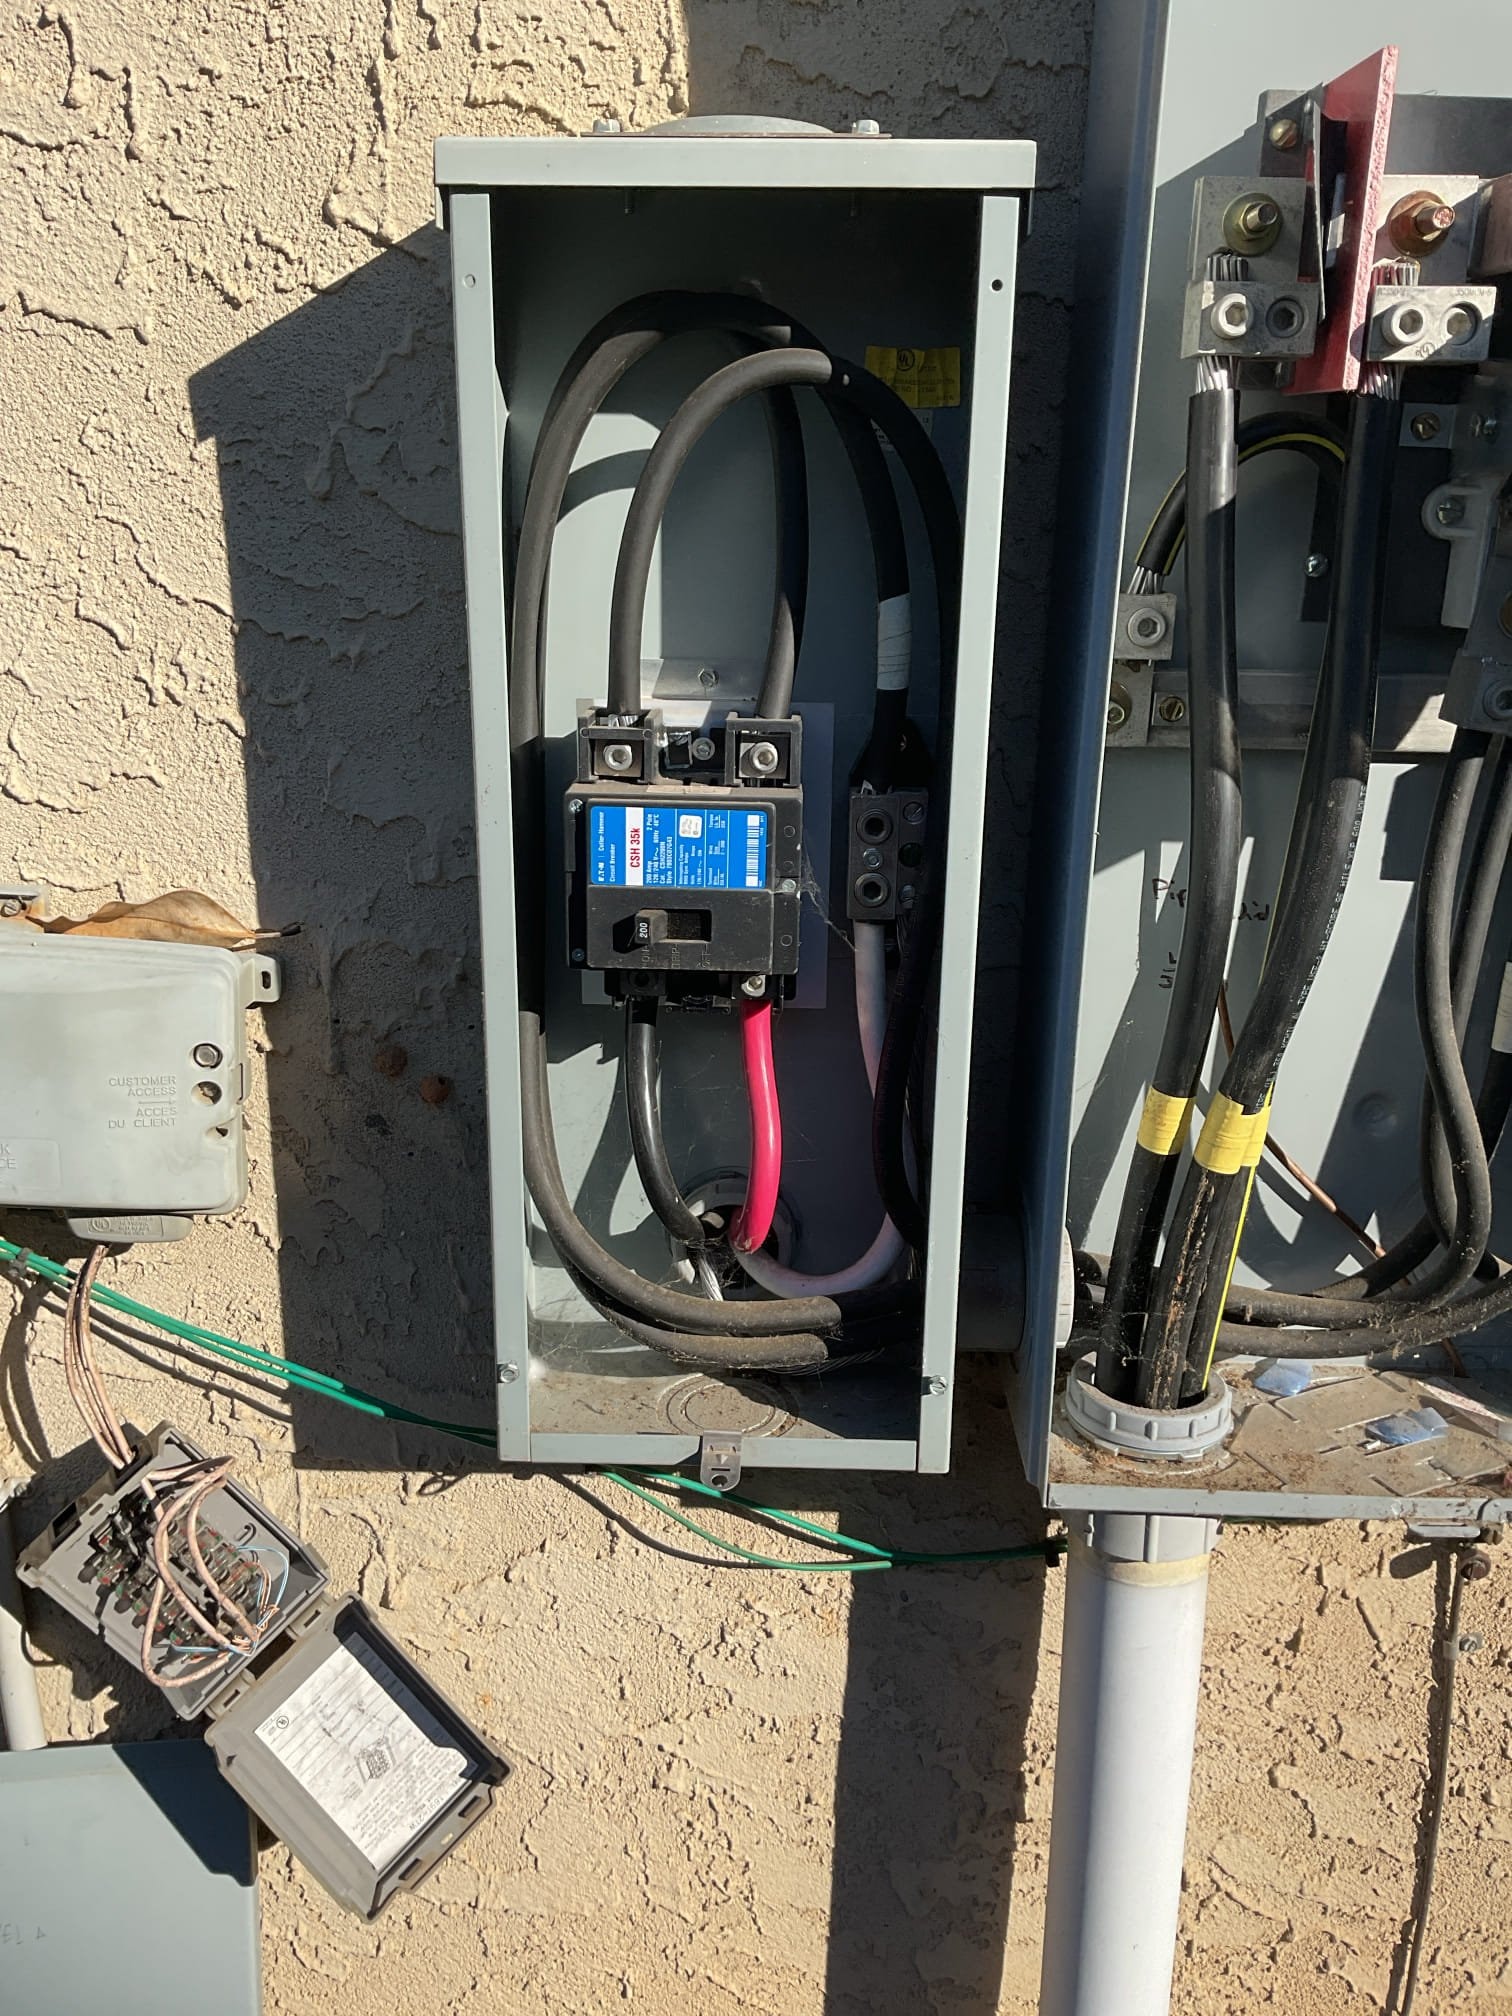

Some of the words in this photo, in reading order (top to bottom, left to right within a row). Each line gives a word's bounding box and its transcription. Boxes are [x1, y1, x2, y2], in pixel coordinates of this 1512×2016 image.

[630, 828, 640, 845] 35k
[630, 848, 640, 868] CSH
[639, 922, 648, 939] 200
[108, 1075, 176, 1087] CUSTOMER
[127, 1087, 177, 1097] ACCESS
[135, 1107, 177, 1118] ACCES
[108, 1119, 126, 1129] DU
[133, 1118, 176, 1129] CLIENT
